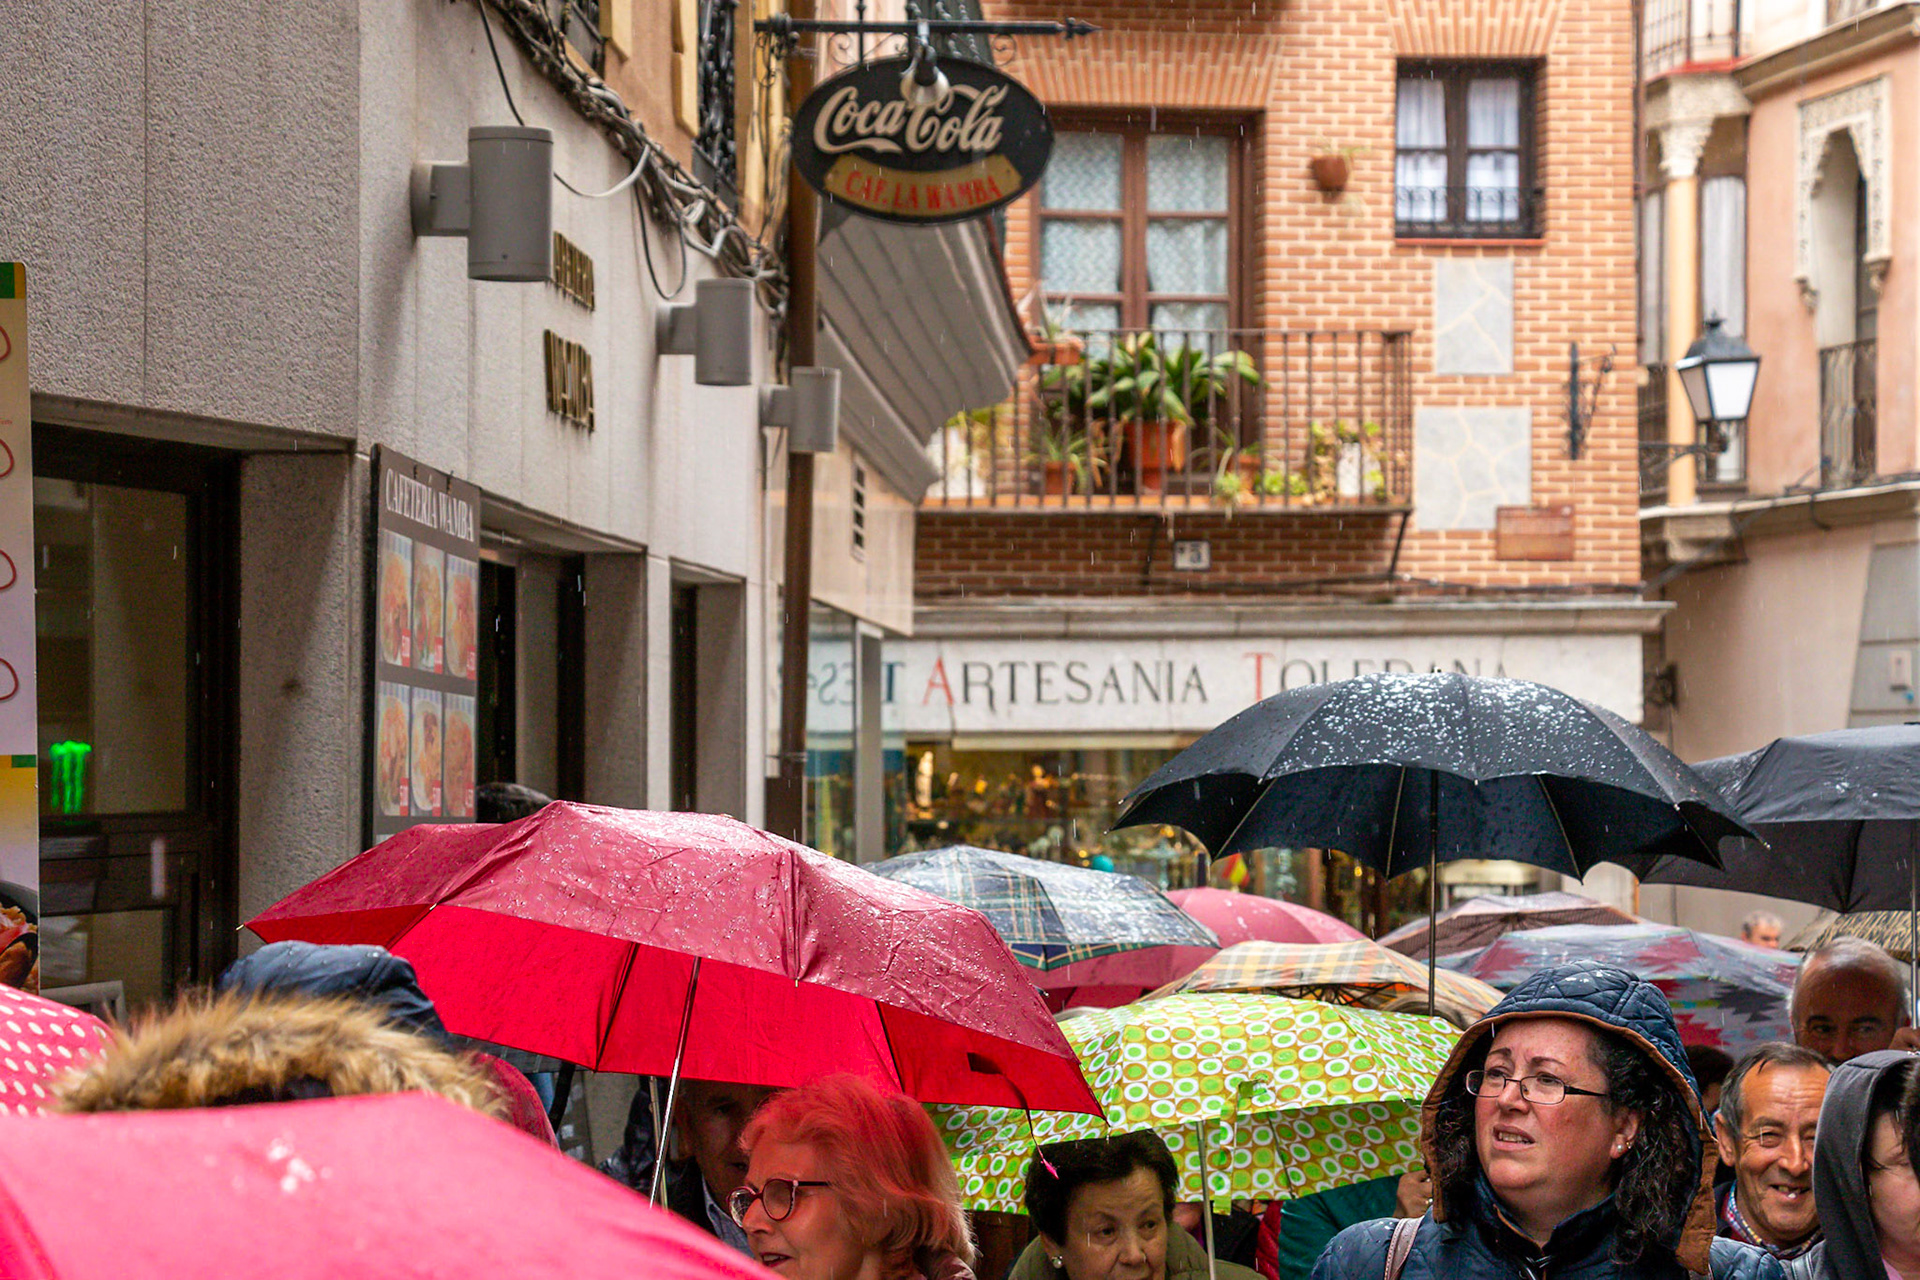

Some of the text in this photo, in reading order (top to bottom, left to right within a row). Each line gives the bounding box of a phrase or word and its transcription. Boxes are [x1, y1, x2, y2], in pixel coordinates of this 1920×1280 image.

[813, 83, 1009, 154] Coca Cola
[892, 181, 919, 210] LA
[925, 174, 1004, 210] WAMBA
[438, 491, 475, 543] WAMBA
[922, 656, 1208, 713] ARTESANIA
